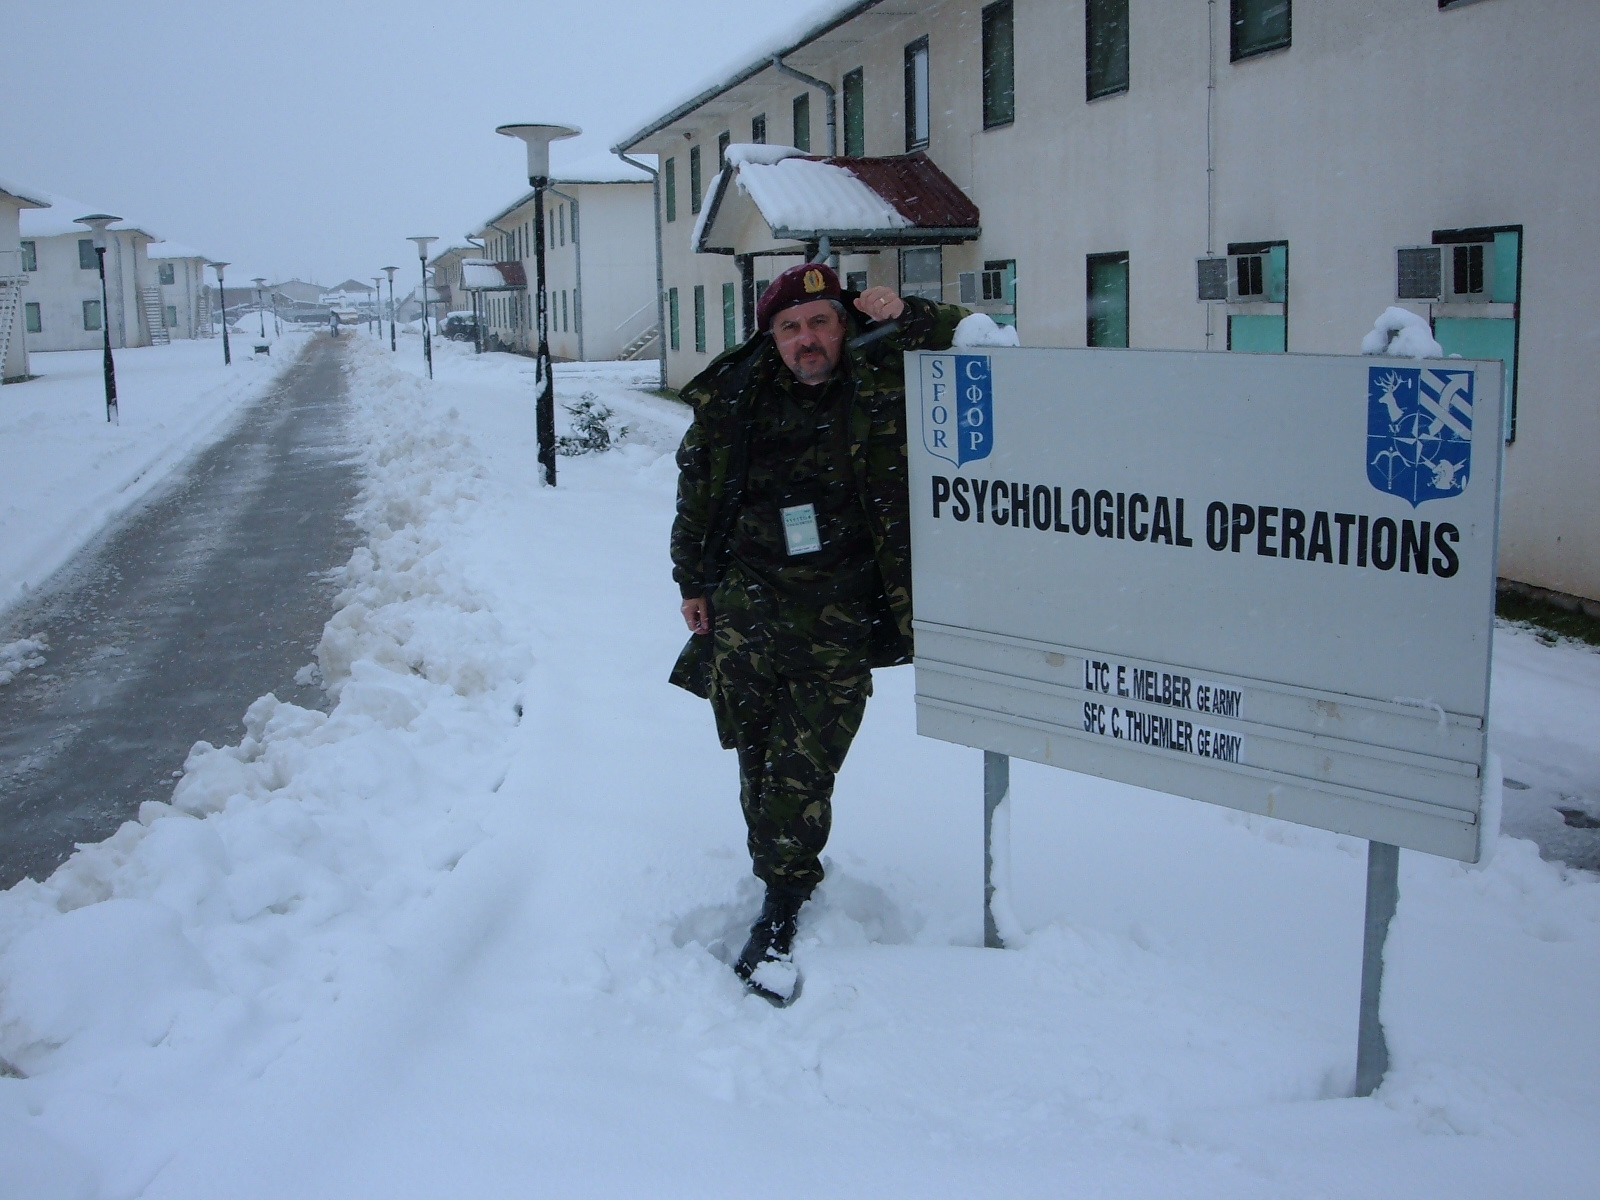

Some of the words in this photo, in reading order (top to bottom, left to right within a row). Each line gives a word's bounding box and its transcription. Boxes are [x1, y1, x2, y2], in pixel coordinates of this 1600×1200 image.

[931, 360, 948, 448] SFOR
[966, 361, 984, 450] СФОР
[932, 475, 1193, 547] PSYCHOLOGICAL
[1206, 501, 1460, 578] OPERATIONS
[1083, 701, 1106, 735] SFC
[1111, 707, 1123, 739] C.
[1125, 710, 1193, 753] THUEMLER
[1197, 728, 1210, 757] GE
[1212, 732, 1242, 764] ARMY
[1085, 659, 1110, 694] LTC
[1117, 665, 1129, 697] E.
[1133, 668, 1192, 709] MELBER
[1196, 685, 1210, 713] GE
[1212, 688, 1242, 718] ARMY
